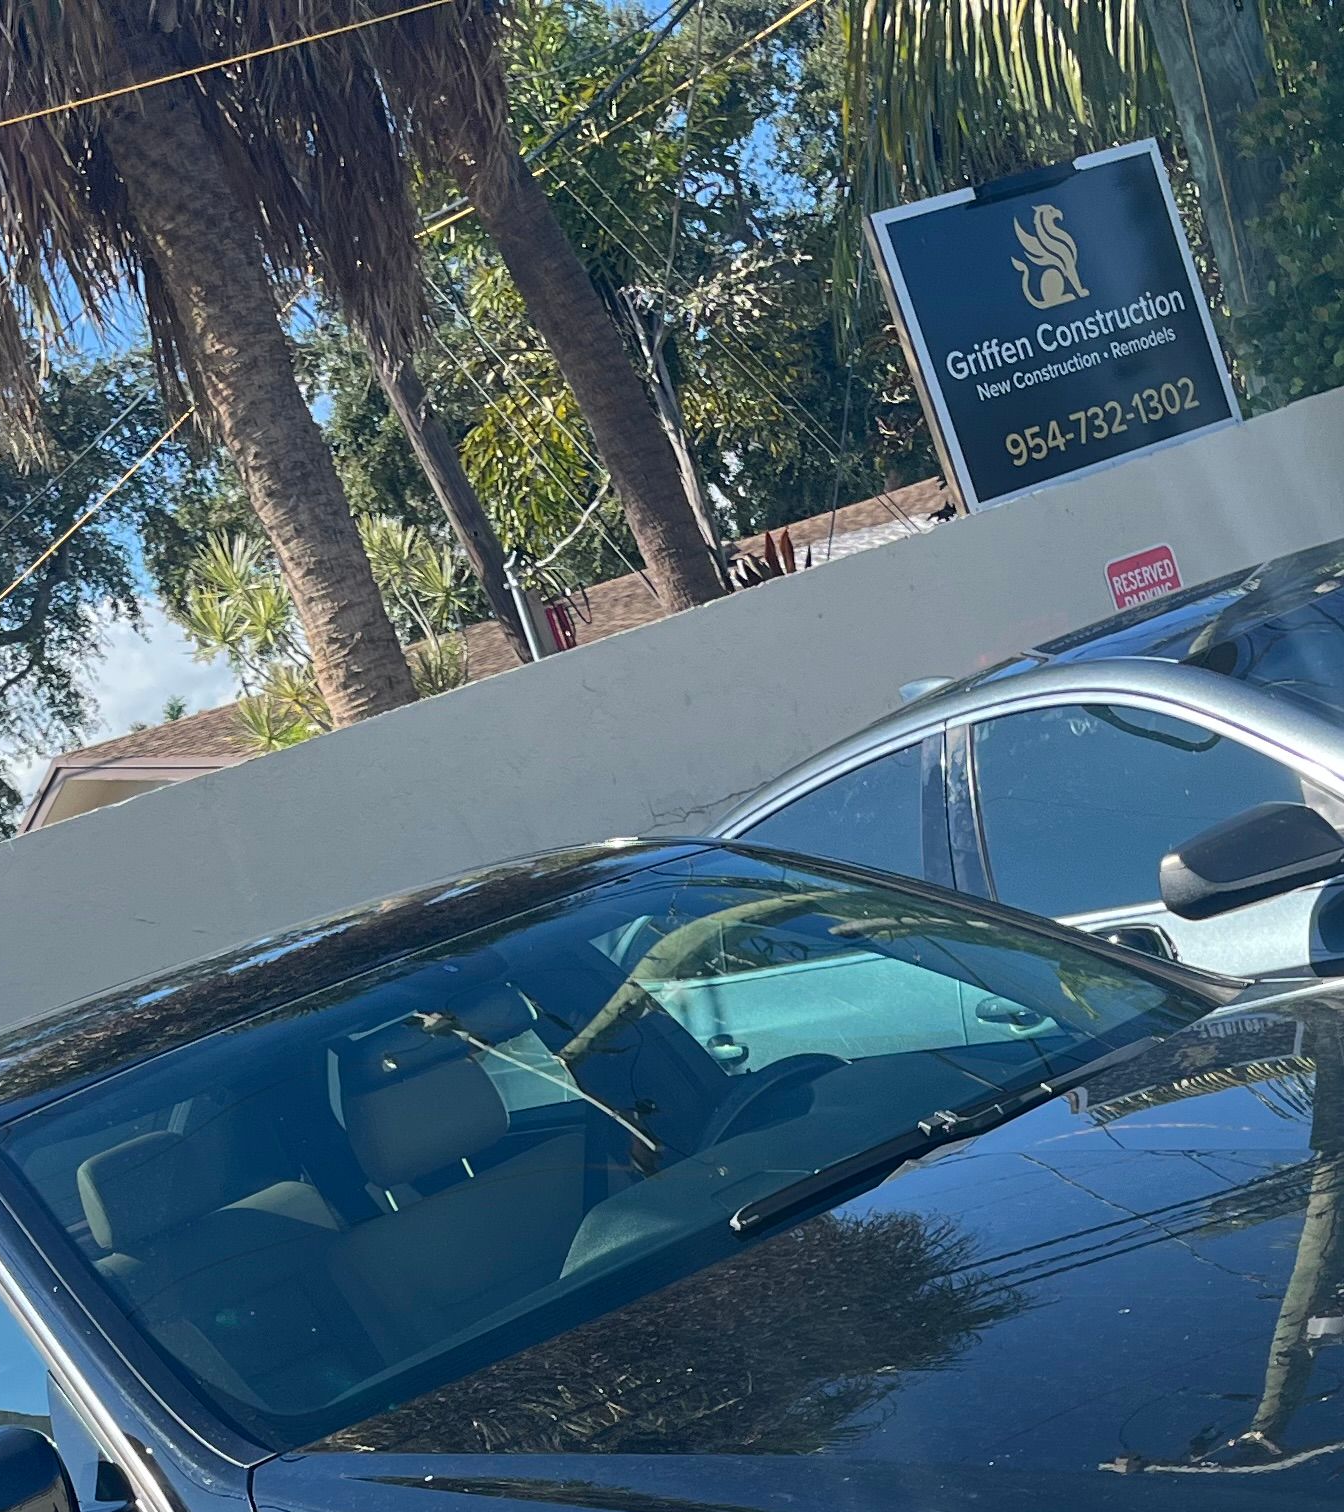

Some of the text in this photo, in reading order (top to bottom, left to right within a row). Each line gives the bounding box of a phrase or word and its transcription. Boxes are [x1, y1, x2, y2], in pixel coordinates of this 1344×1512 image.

[945, 289, 1186, 380] Griffen Construction
[975, 325, 1177, 402] New Construction Remodels
[1005, 376, 1201, 467] 954-732-1302
[1112, 558, 1174, 596] RESERVED
